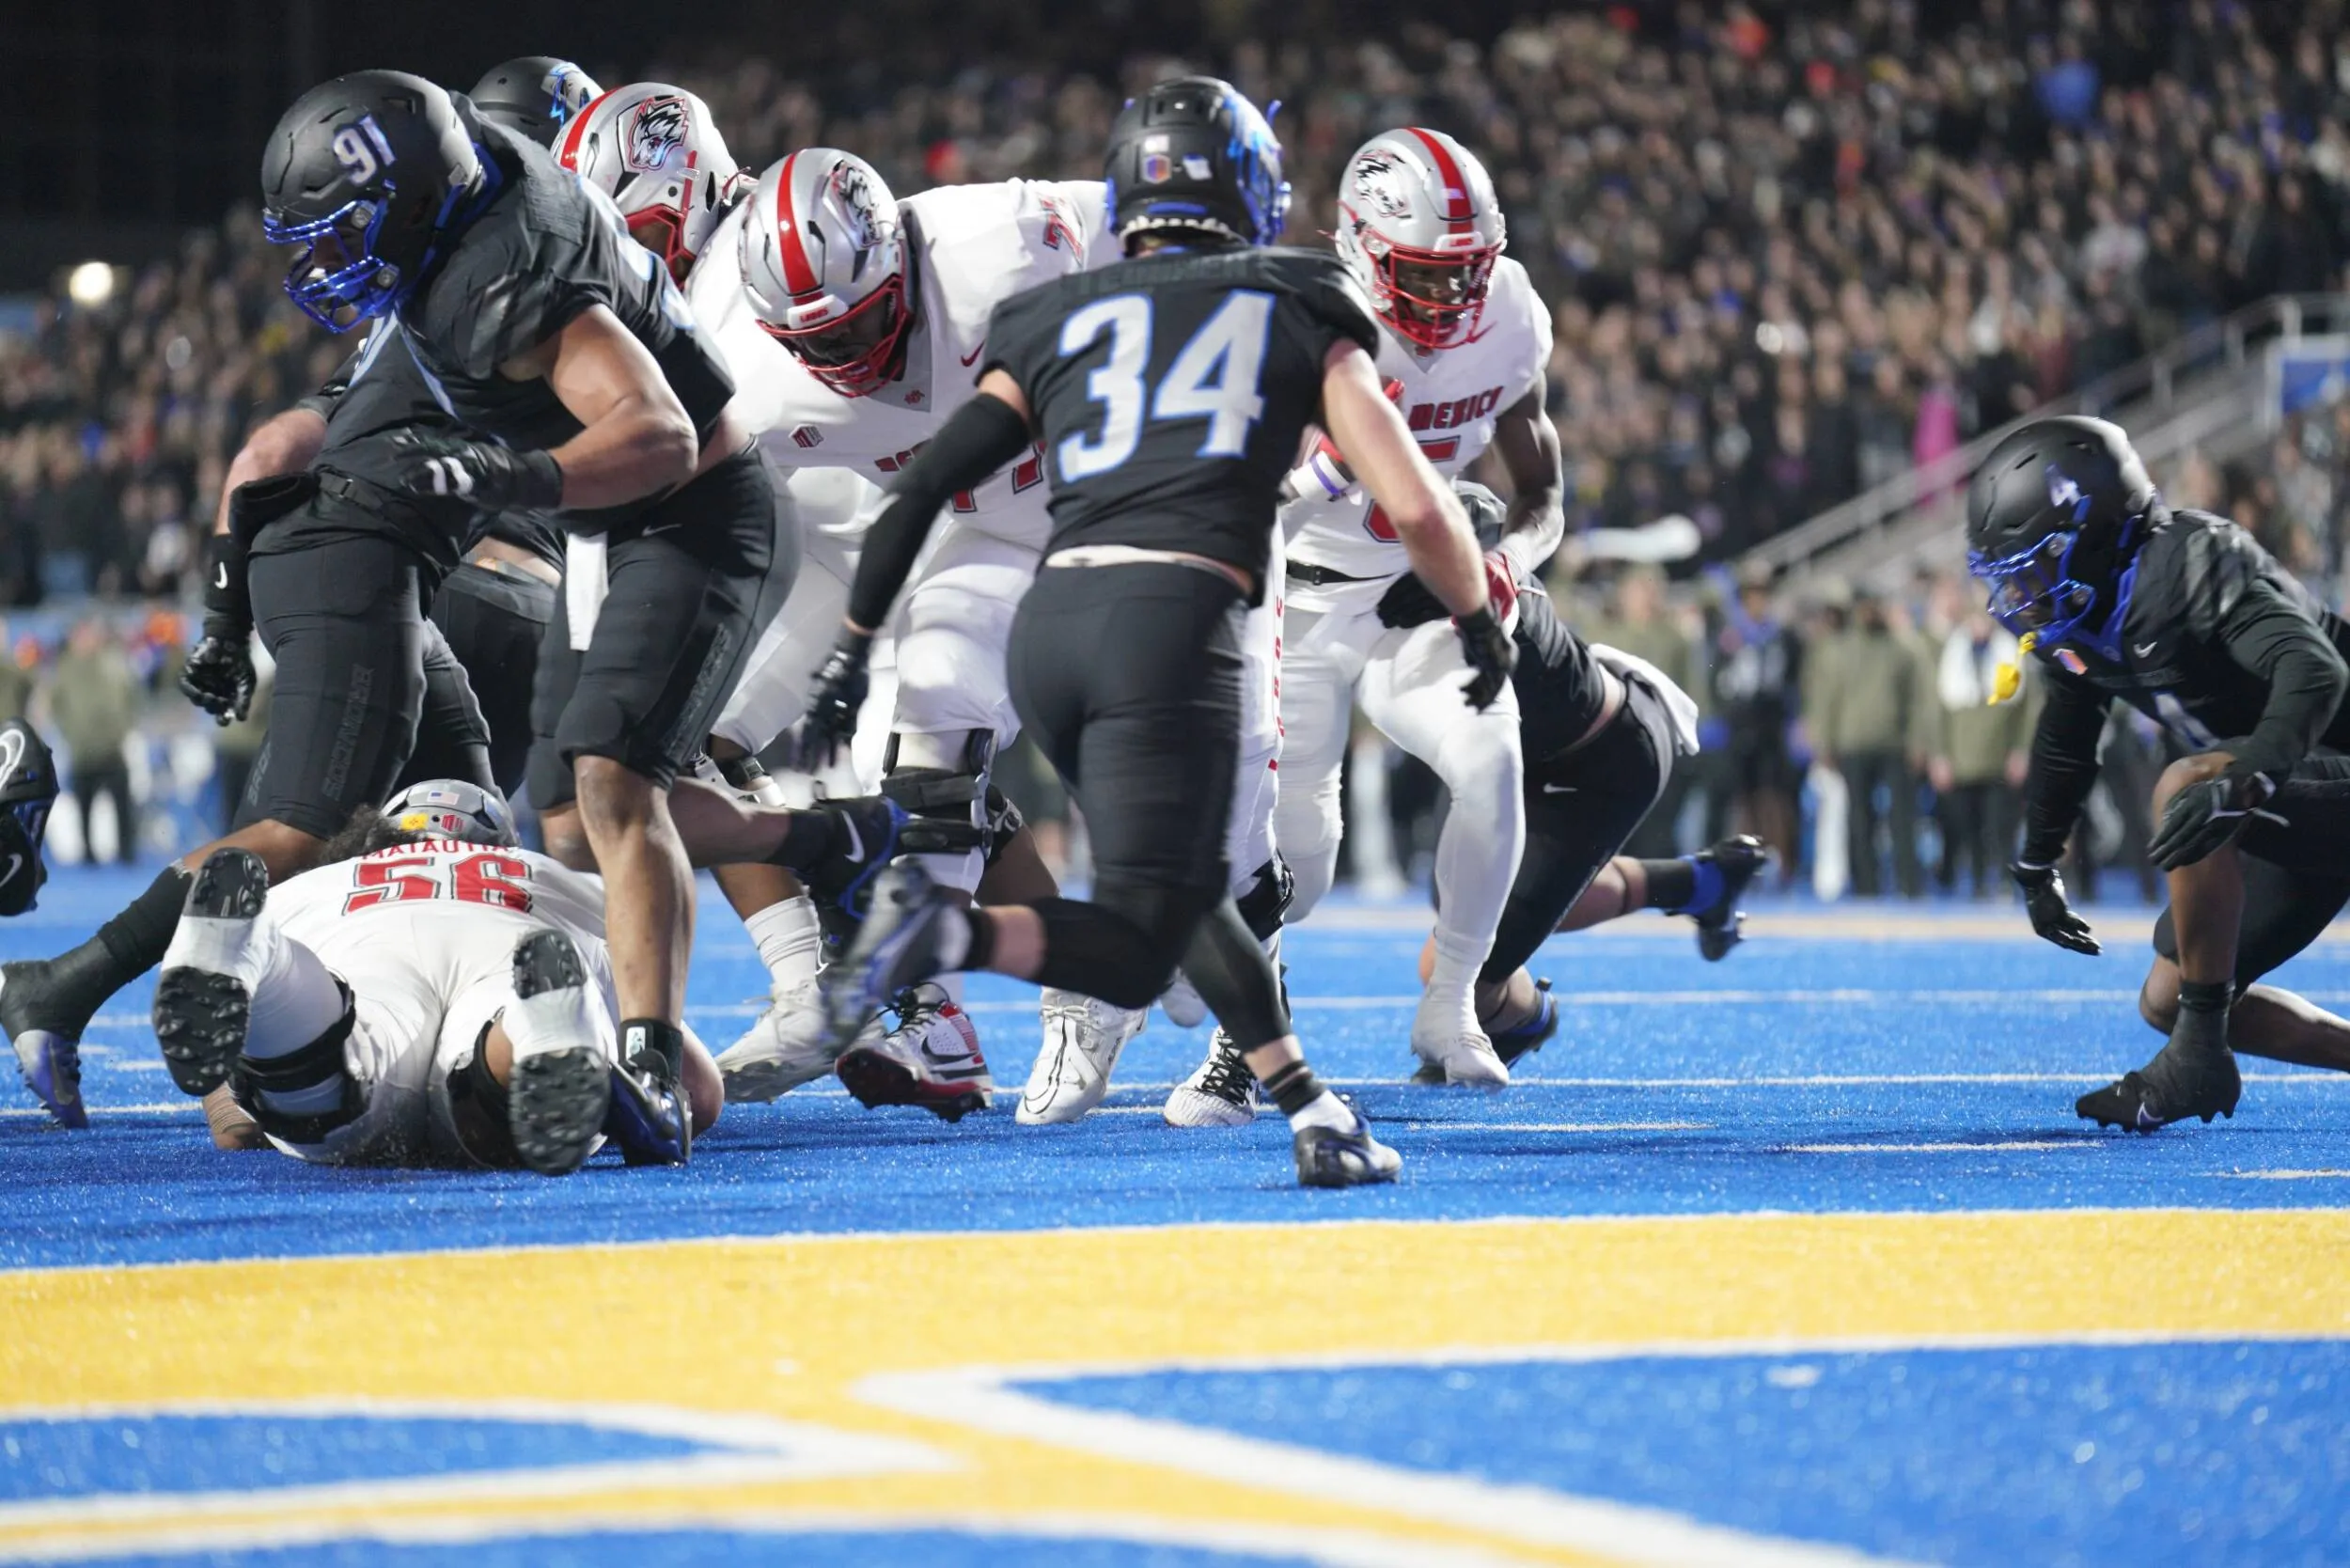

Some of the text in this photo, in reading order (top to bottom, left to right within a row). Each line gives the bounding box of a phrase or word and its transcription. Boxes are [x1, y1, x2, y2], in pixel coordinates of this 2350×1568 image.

[333, 114, 397, 185] 91
[1057, 288, 1277, 484] 34
[1408, 384, 1504, 431] MEXICO
[2044, 462, 2081, 508] 4
[341, 852, 533, 917] 56
